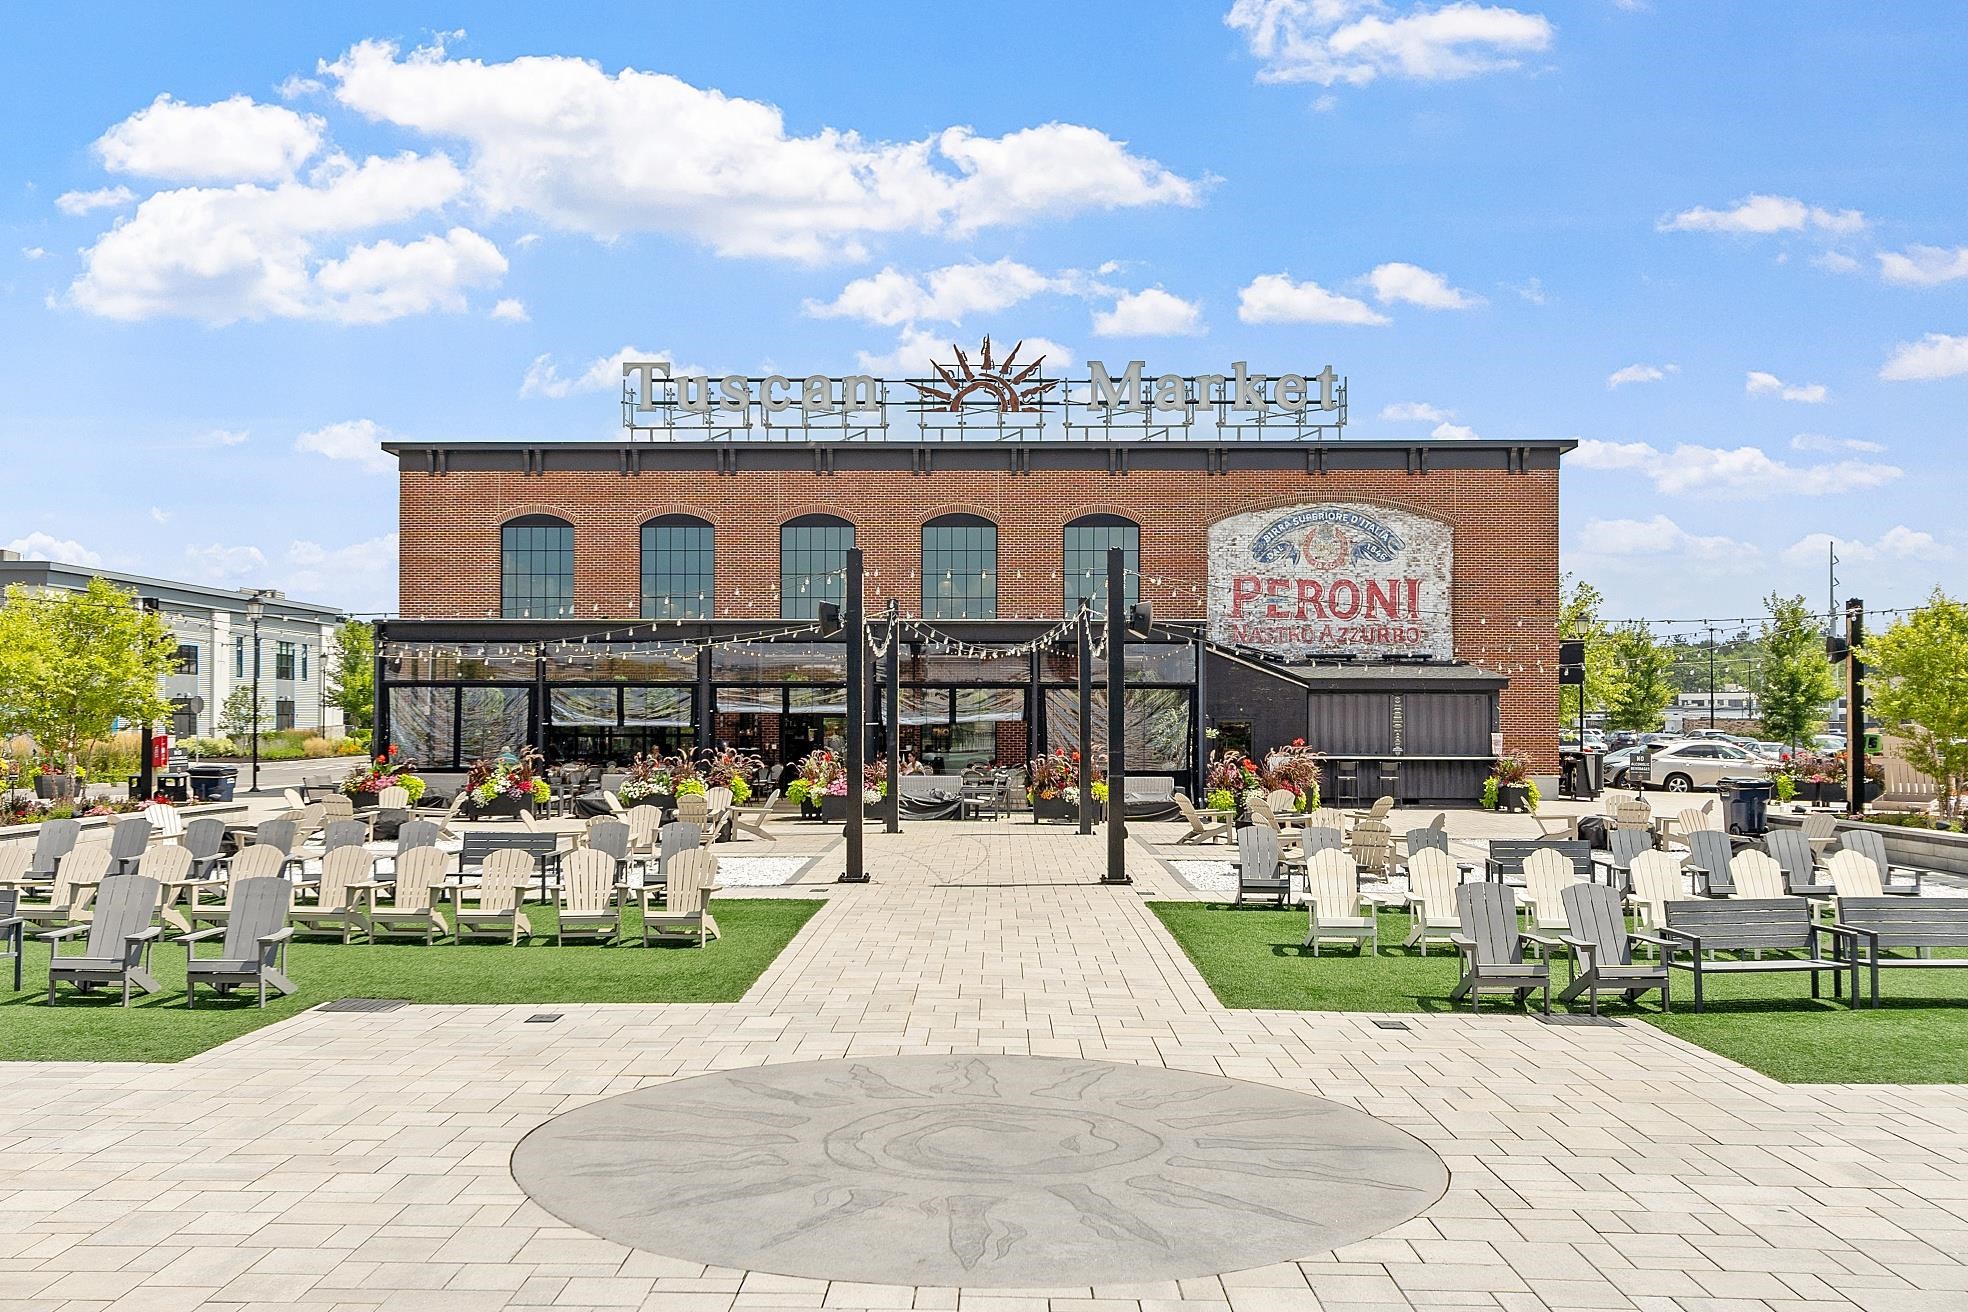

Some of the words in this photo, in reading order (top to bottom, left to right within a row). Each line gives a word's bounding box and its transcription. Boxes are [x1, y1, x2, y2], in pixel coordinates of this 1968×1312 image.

[623, 362, 880, 412] Tuscan
[1087, 361, 1339, 411] Market
[1263, 521, 1291, 543] BIRRA
[1365, 543, 1387, 560] 1846
[1230, 575, 1422, 621] PERONI
[1231, 624, 1315, 645] NASTRO
[1319, 623, 1422, 645] AZZURRO
